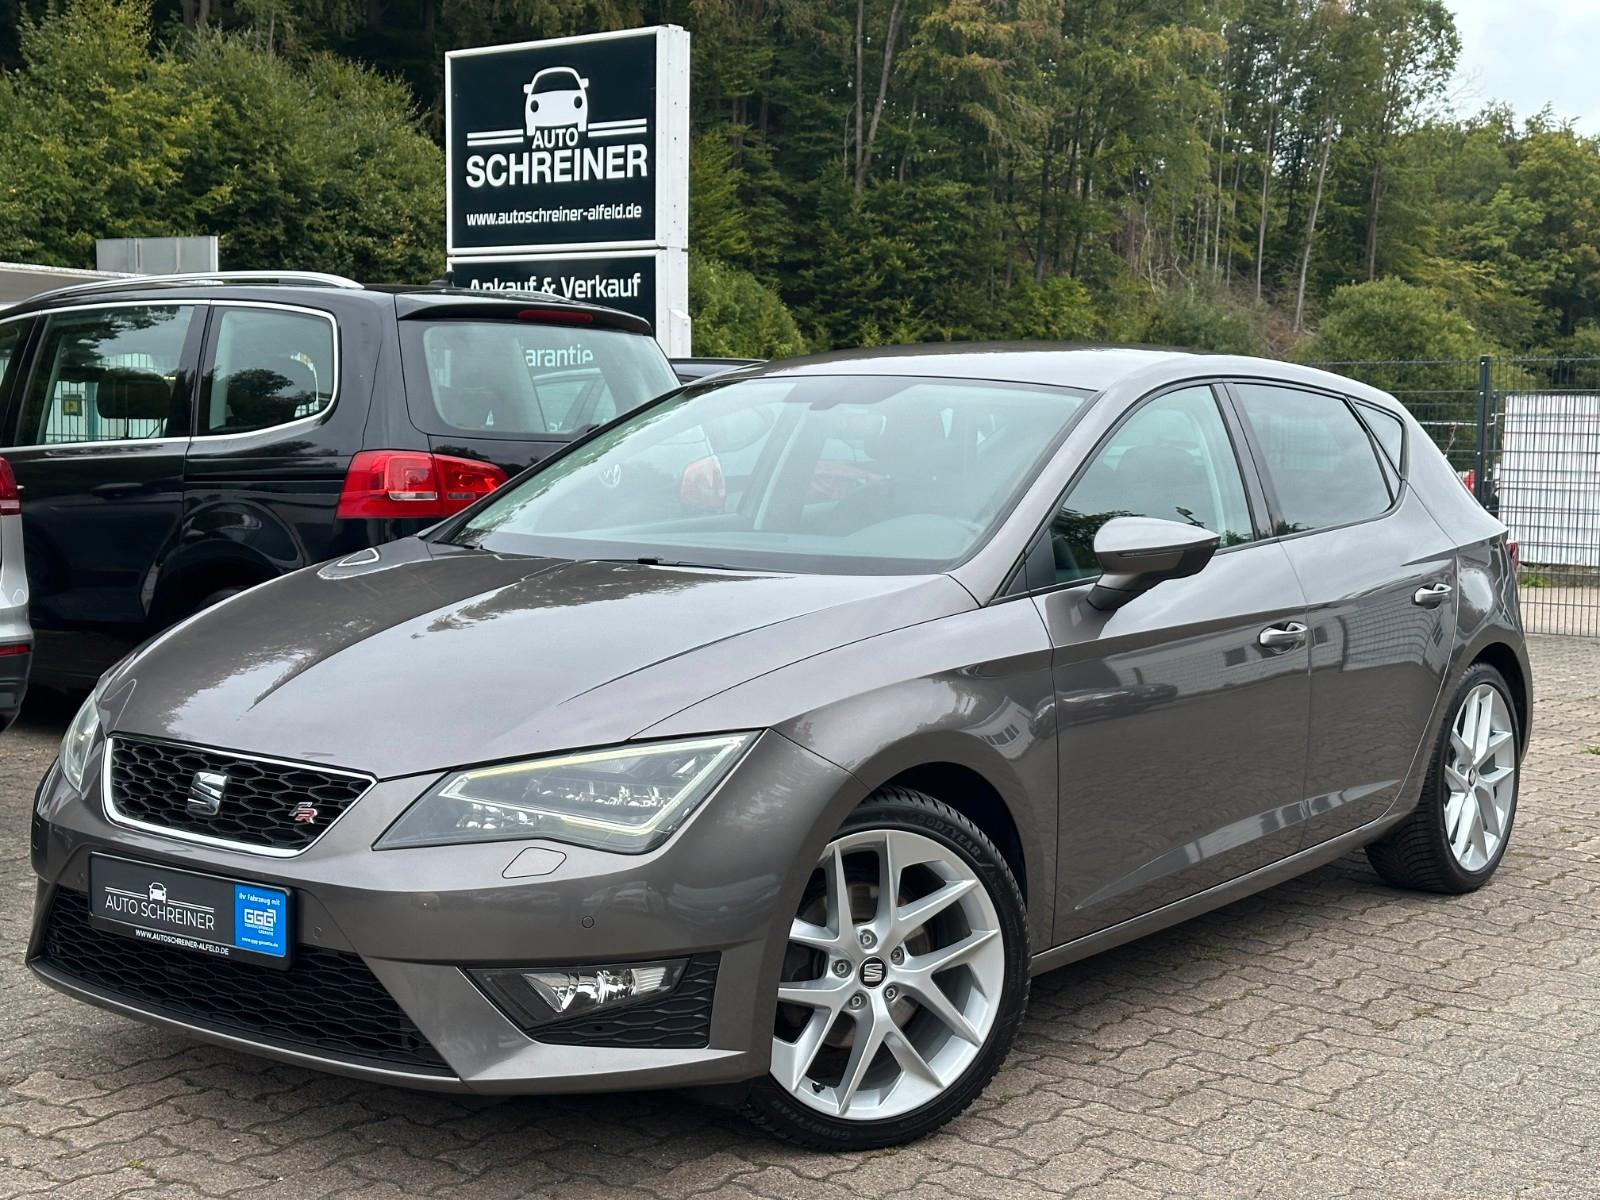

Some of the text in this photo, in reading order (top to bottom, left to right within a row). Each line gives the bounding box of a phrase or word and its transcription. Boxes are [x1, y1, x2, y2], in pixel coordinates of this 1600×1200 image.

[532, 127, 579, 149] AUTO
[465, 143, 648, 188] SCHREINER
[466, 203, 642, 226] www.autoschreiner-alfeld.de
[541, 277, 556, 294] &
[560, 272, 641, 298] Verkauf
[523, 344, 594, 368] arantie
[105, 894, 215, 931] AUTO SCHREINER
[244, 908, 274, 927] GGG
[135, 929, 229, 956] WWW.AUTOSCHREINER-ALFELD.DE
